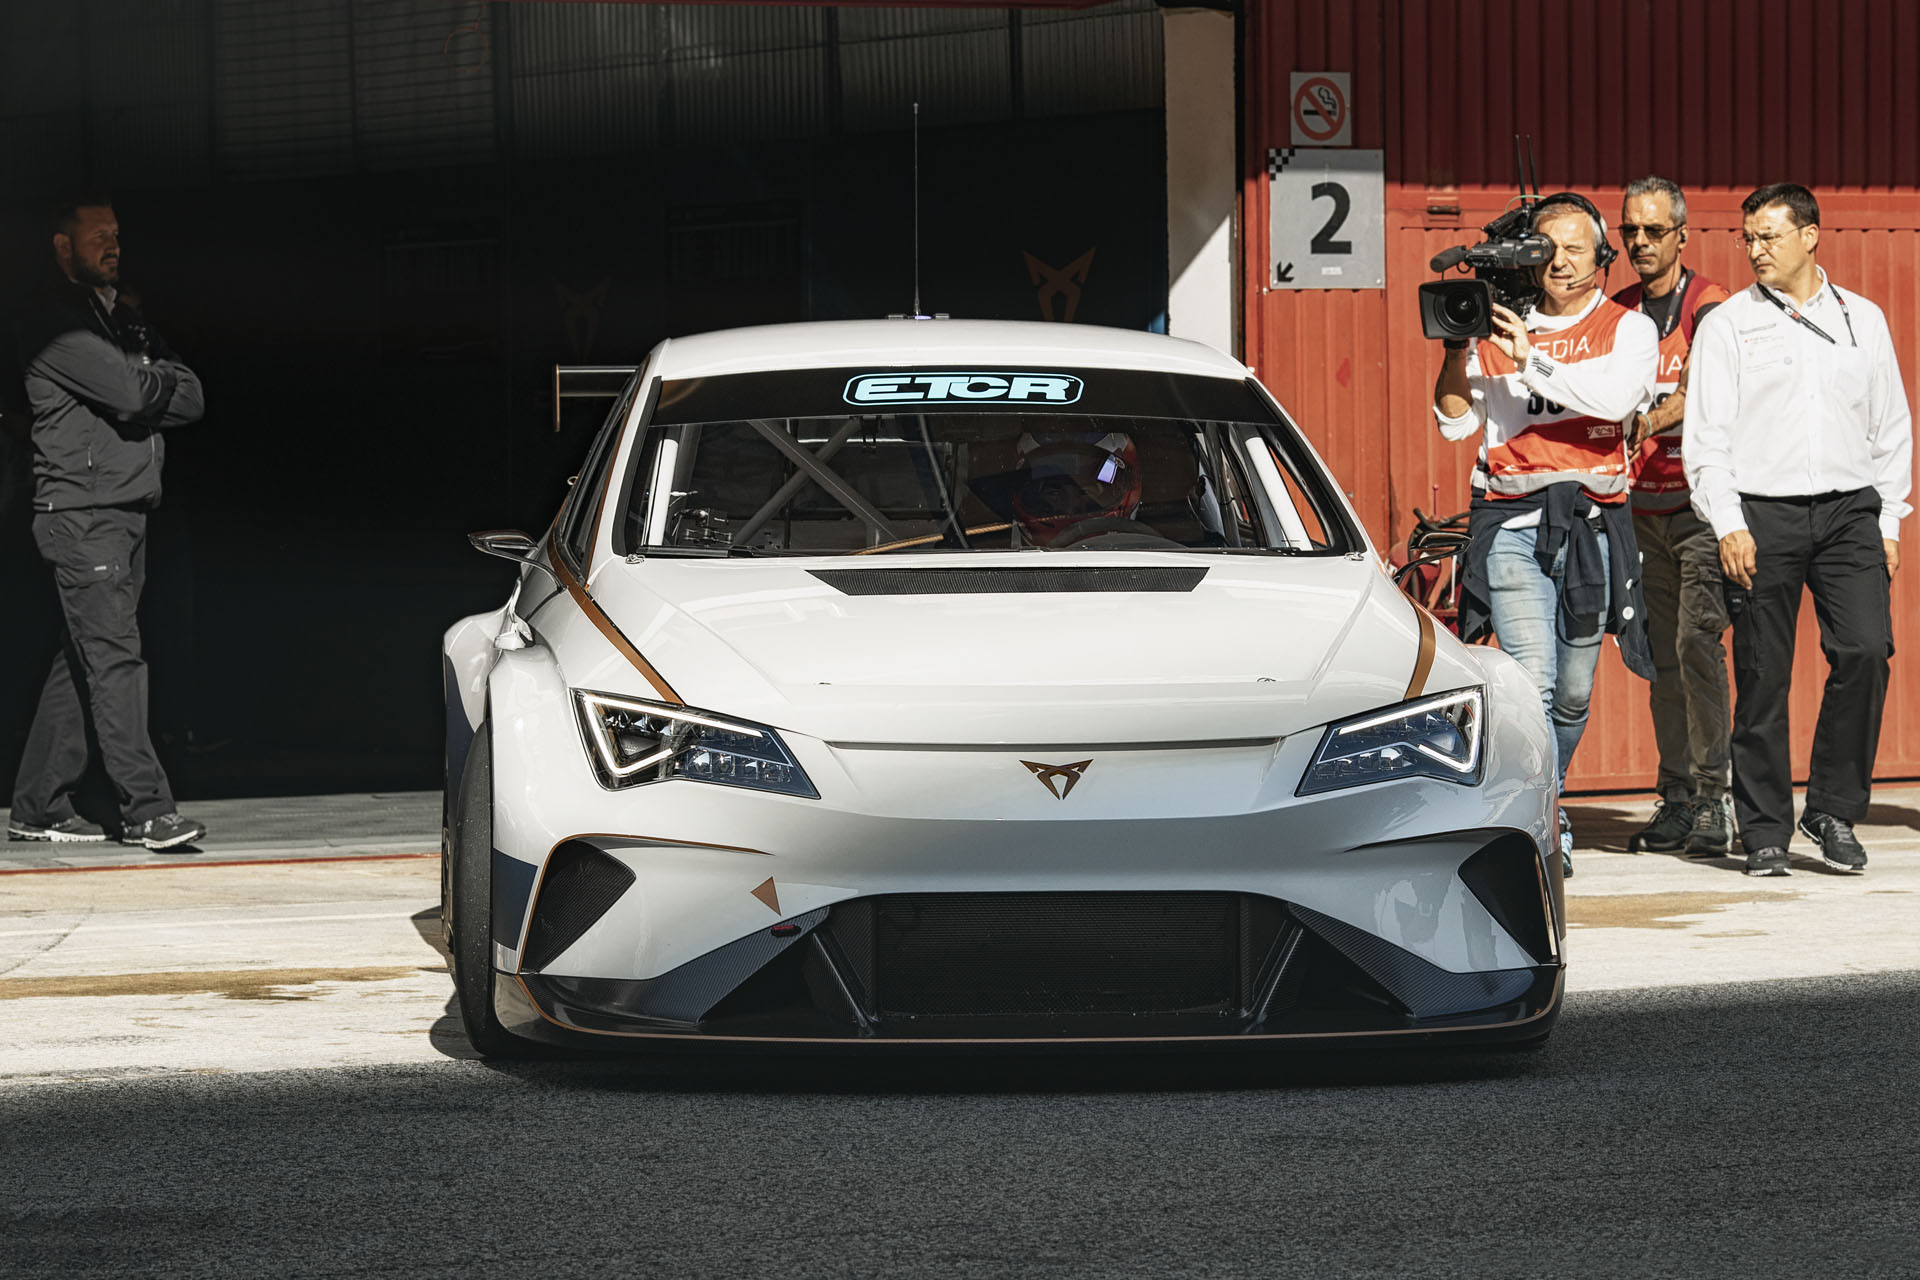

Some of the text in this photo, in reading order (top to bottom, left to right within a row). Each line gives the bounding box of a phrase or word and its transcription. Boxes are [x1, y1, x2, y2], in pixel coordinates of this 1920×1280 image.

[1310, 181, 1352, 255] 2
[1534, 335, 1591, 359] EDIA
[854, 376, 1070, 401] ETCR
